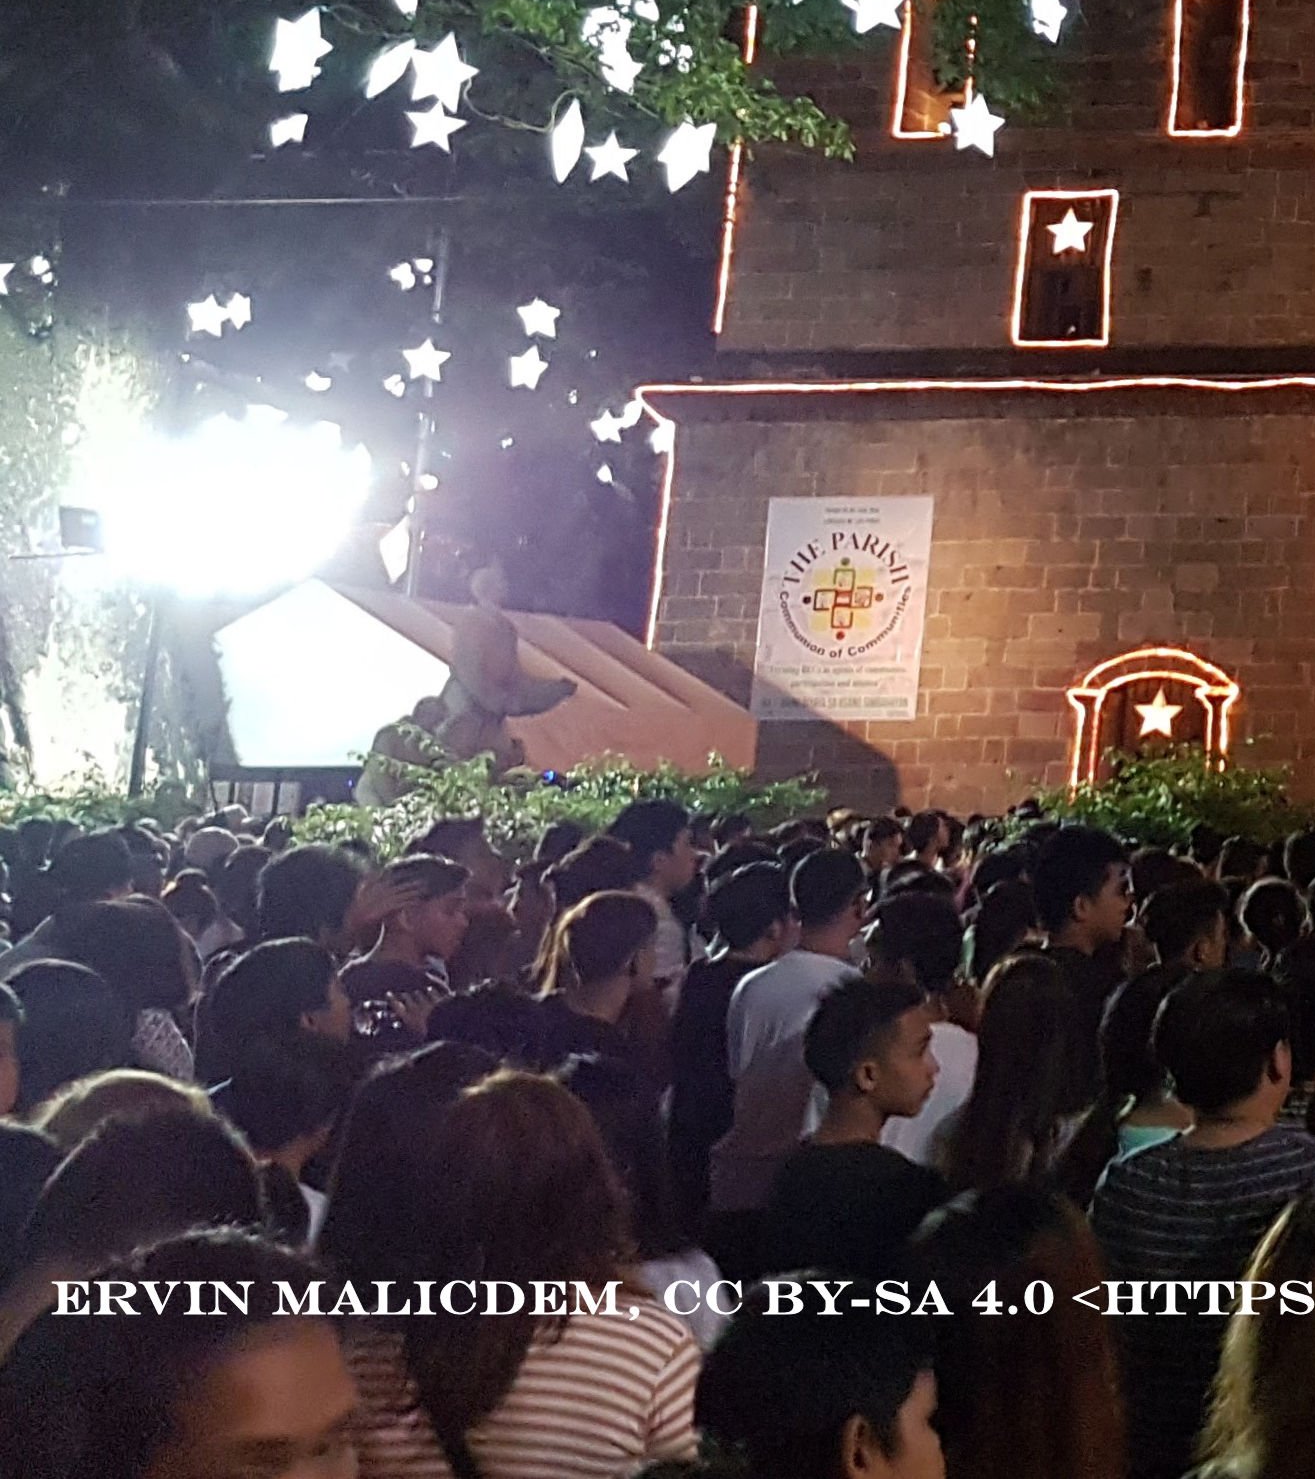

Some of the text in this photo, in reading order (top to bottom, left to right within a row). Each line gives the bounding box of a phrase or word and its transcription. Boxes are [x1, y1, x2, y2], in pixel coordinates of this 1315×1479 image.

[781, 530, 910, 587] THE PARISH
[779, 585, 912, 659] Communion of Communities
